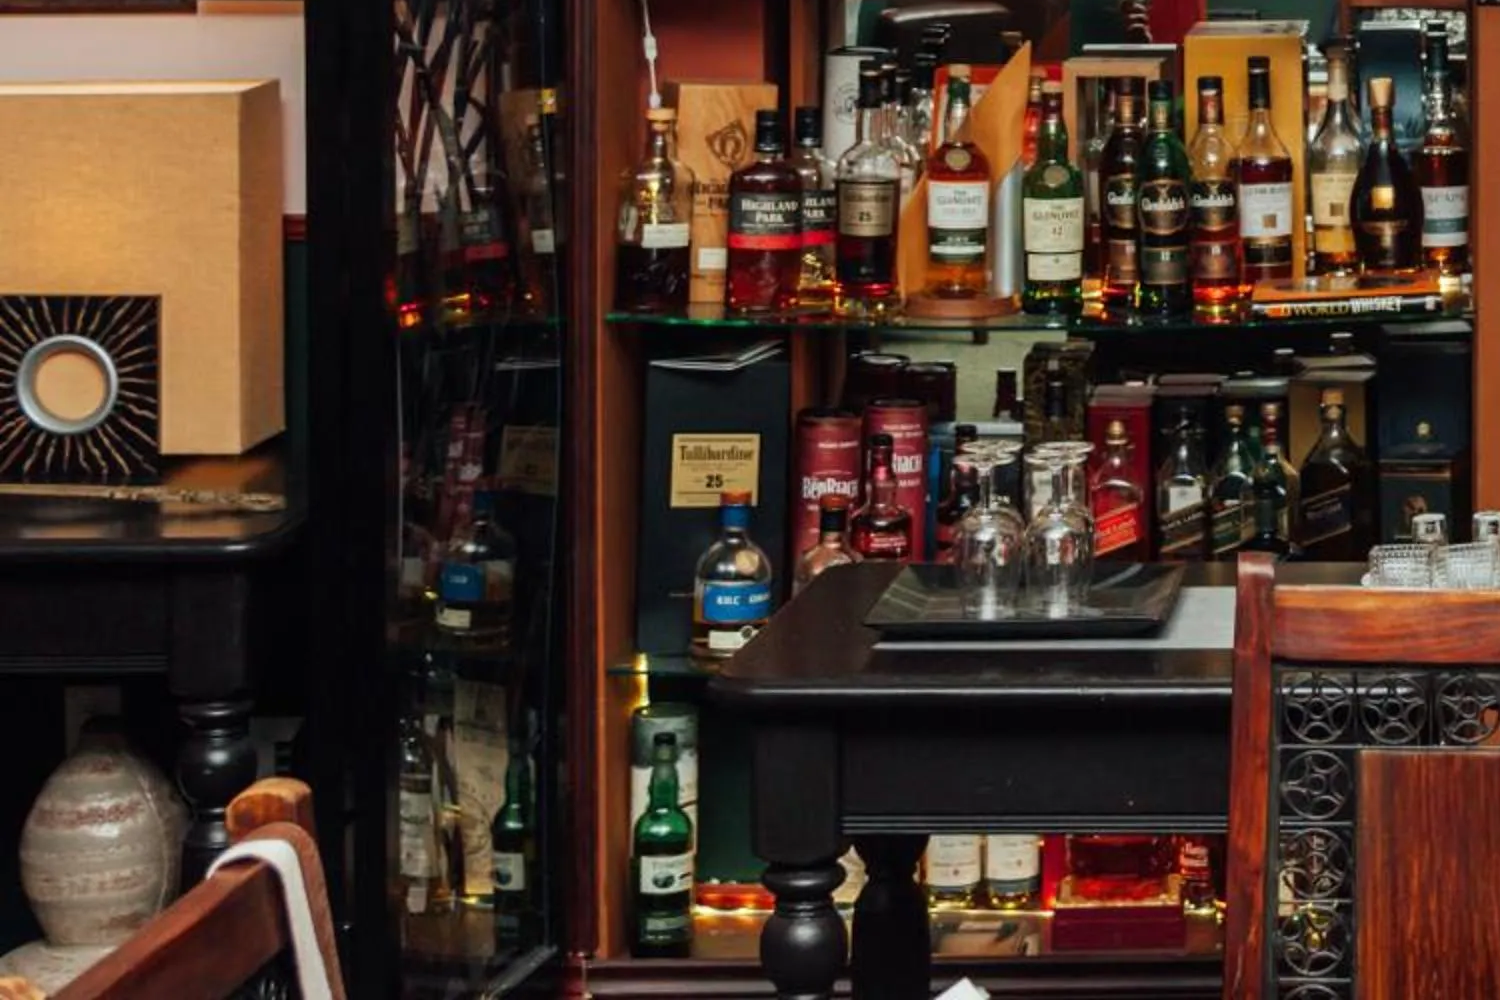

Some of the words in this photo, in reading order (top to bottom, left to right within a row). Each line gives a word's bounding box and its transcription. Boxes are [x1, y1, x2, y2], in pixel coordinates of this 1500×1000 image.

[741, 199, 799, 212] HIGHLAND
[755, 212, 786, 223] PARK
[677, 441, 753, 462] Tullibardine
[704, 474, 724, 489] 25
